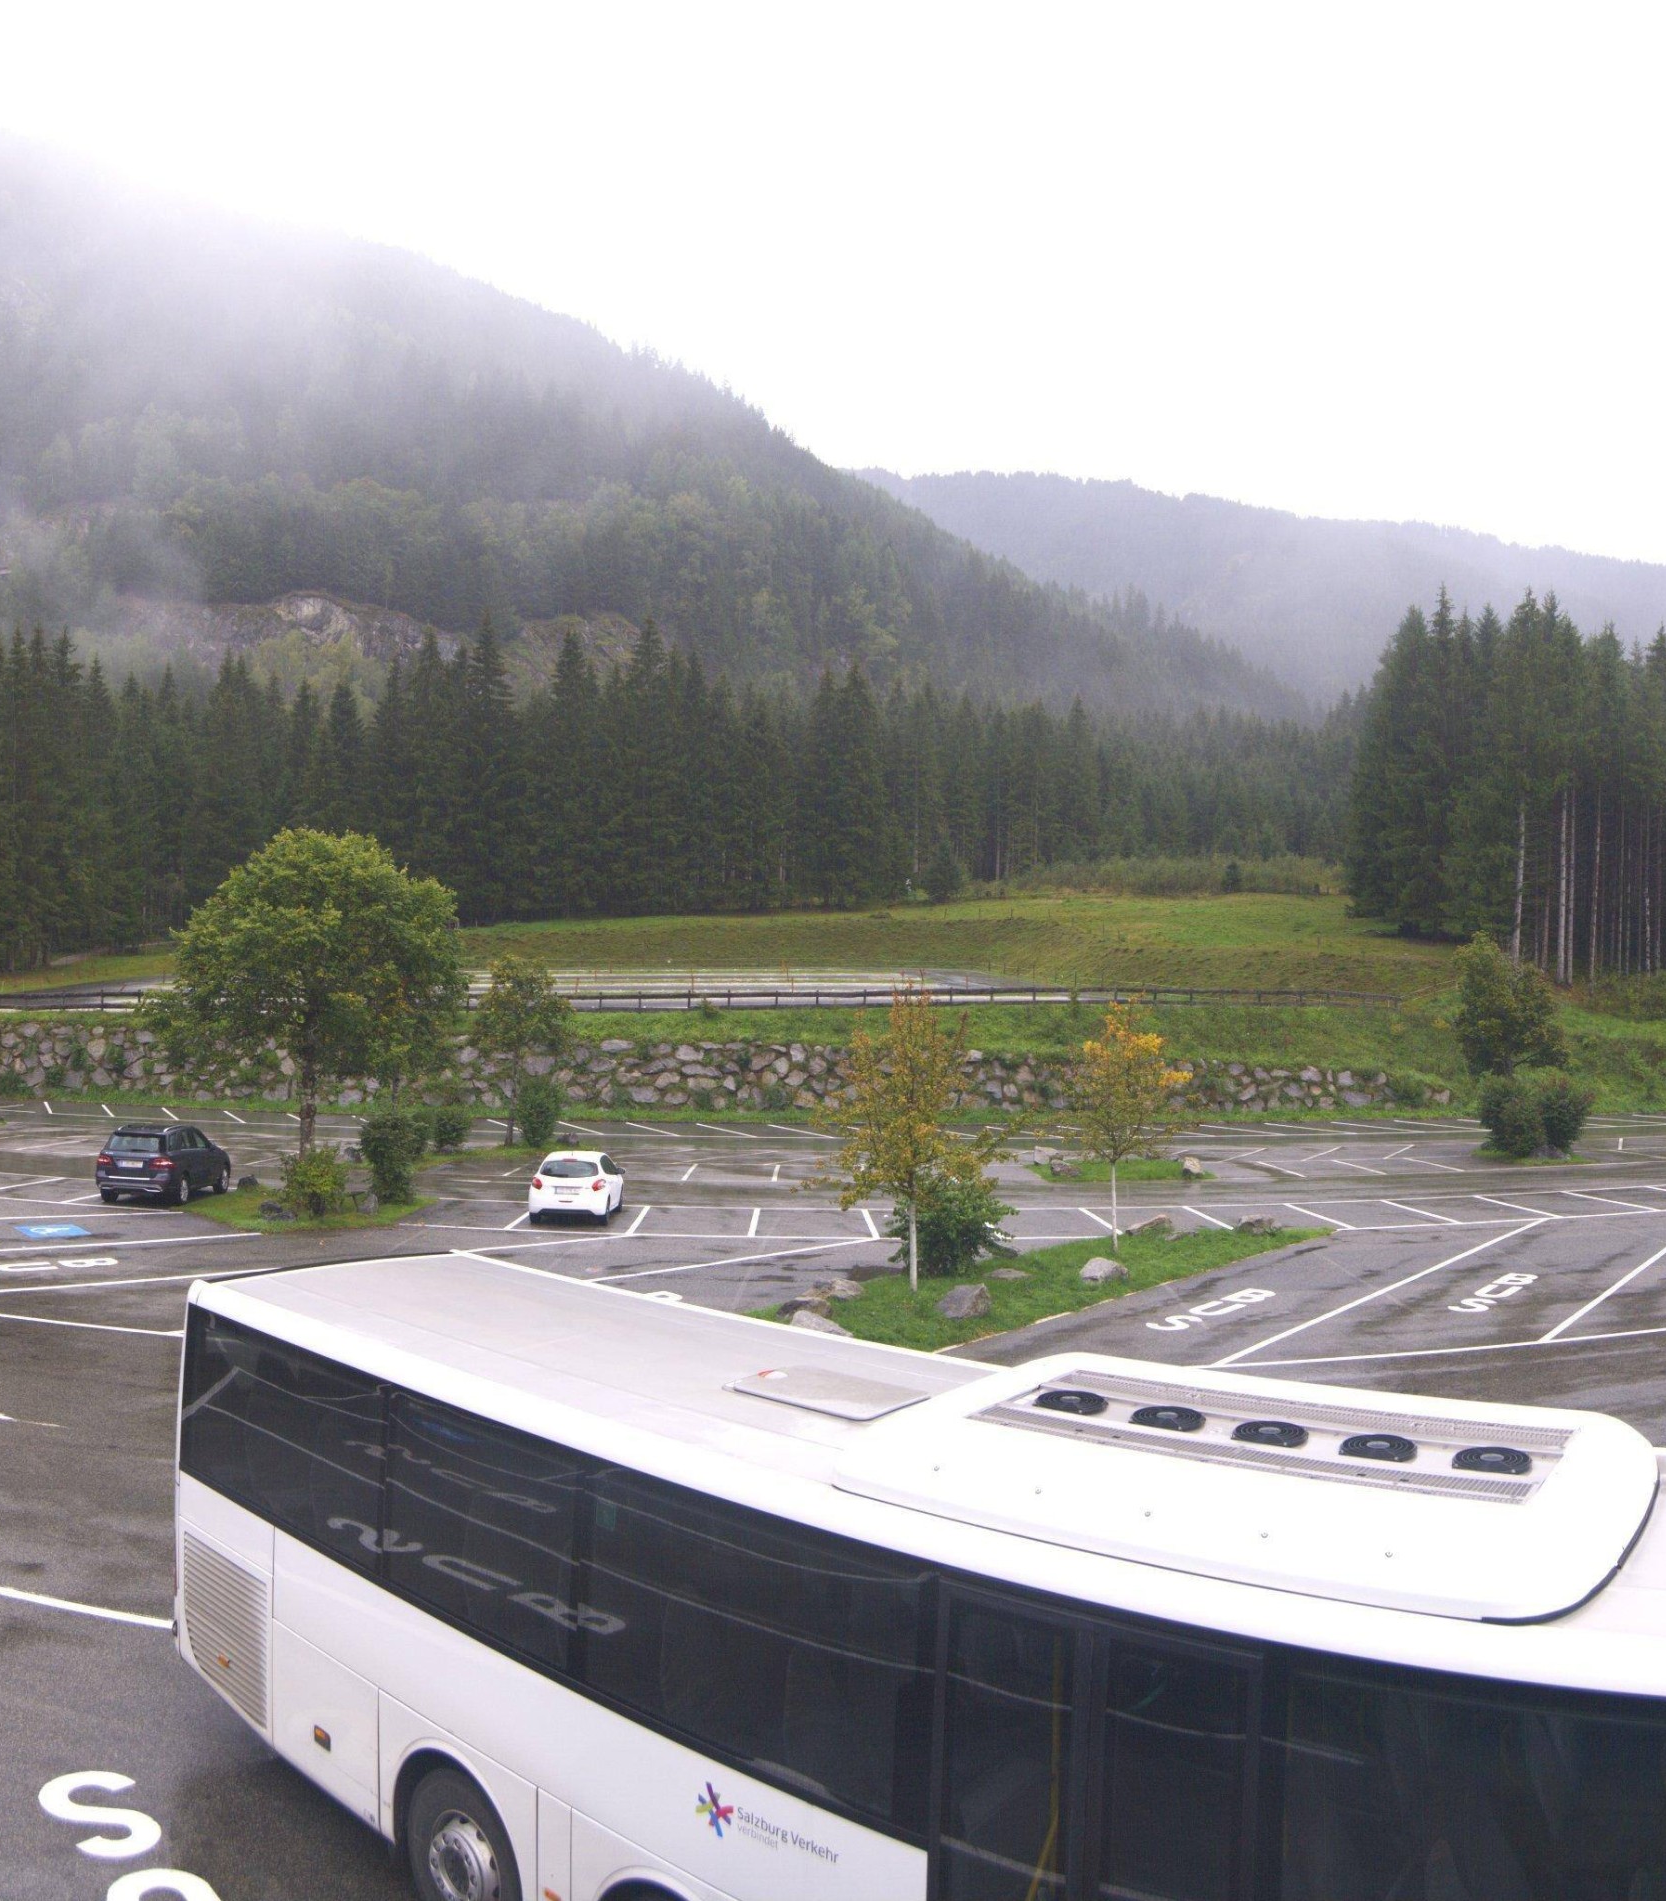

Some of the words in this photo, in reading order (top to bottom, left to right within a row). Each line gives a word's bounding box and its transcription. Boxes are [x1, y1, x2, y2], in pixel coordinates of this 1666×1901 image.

[1145, 1287, 1277, 1331] BUS
[1447, 1272, 1539, 1313] BUS
[737, 1806, 789, 1844] Salzburg
[790, 1830, 840, 1864] Verkehr
[737, 1823, 779, 1850] verbindet
